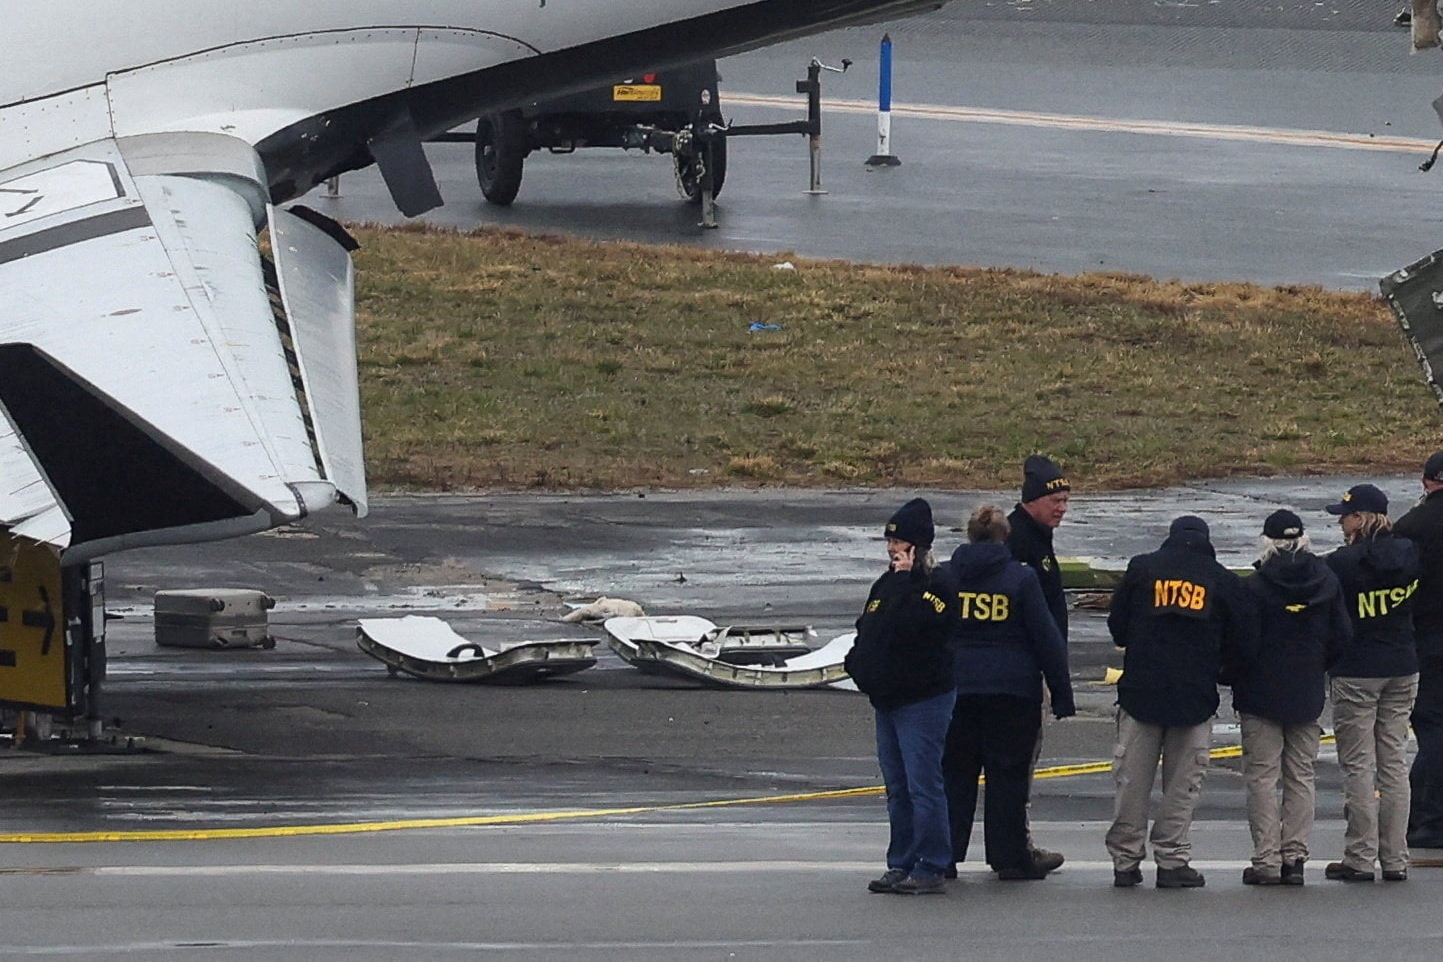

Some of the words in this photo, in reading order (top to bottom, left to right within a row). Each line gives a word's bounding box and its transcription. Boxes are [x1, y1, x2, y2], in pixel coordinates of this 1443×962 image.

[922, 591, 946, 613] NTSB
[958, 591, 1009, 621] TSB
[1154, 579, 1206, 610] NTSB
